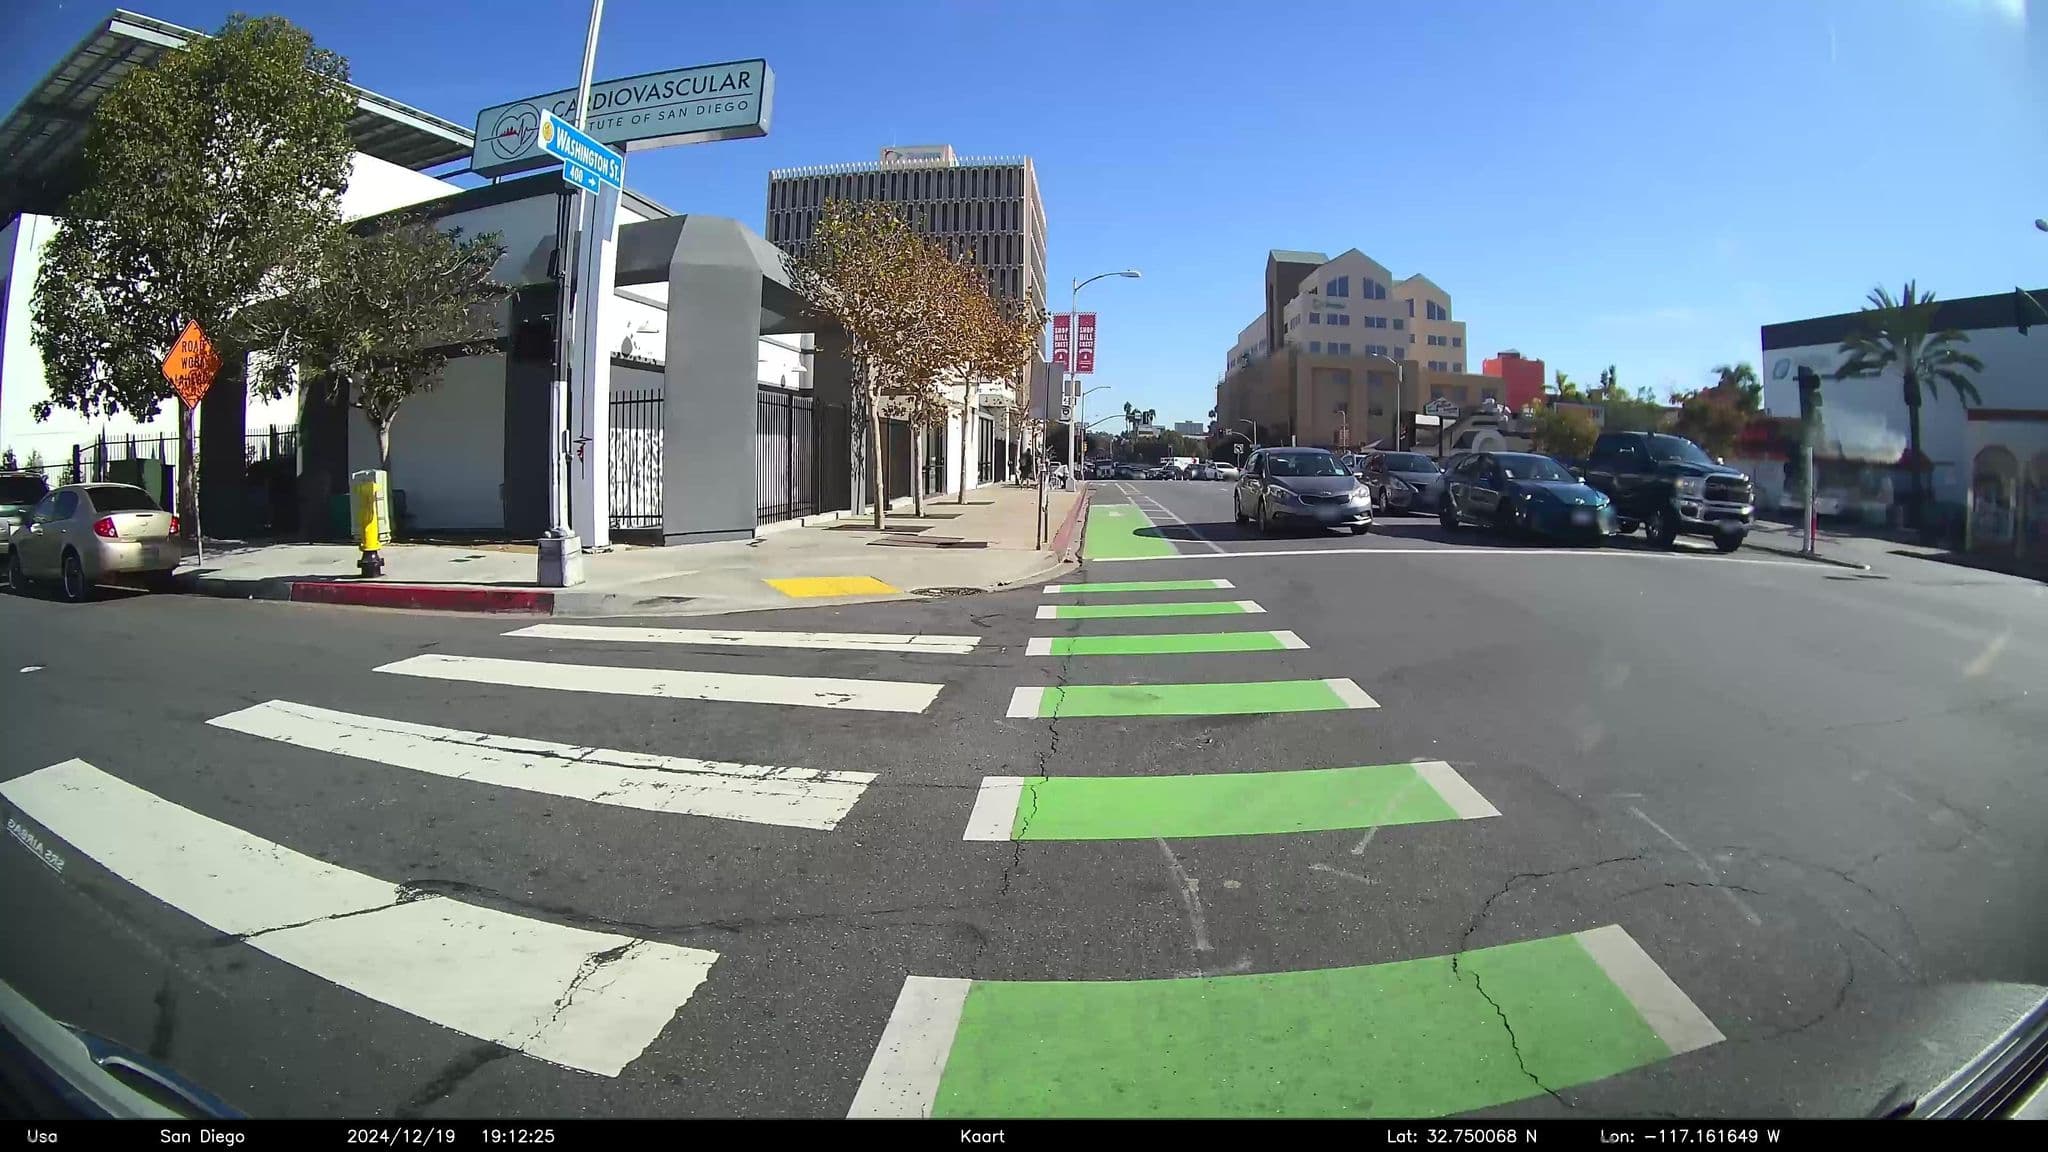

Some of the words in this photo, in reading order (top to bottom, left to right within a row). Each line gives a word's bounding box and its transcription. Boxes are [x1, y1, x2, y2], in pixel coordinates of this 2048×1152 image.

[631, 113, 651, 125] OF
[658, 107, 688, 121] SAN
[696, 100, 749, 116] DIEGO
[556, 127, 609, 176] WASHINGTON
[569, 164, 585, 184] 400
[181, 340, 205, 353] ROAD
[181, 357, 206, 369] WORK
